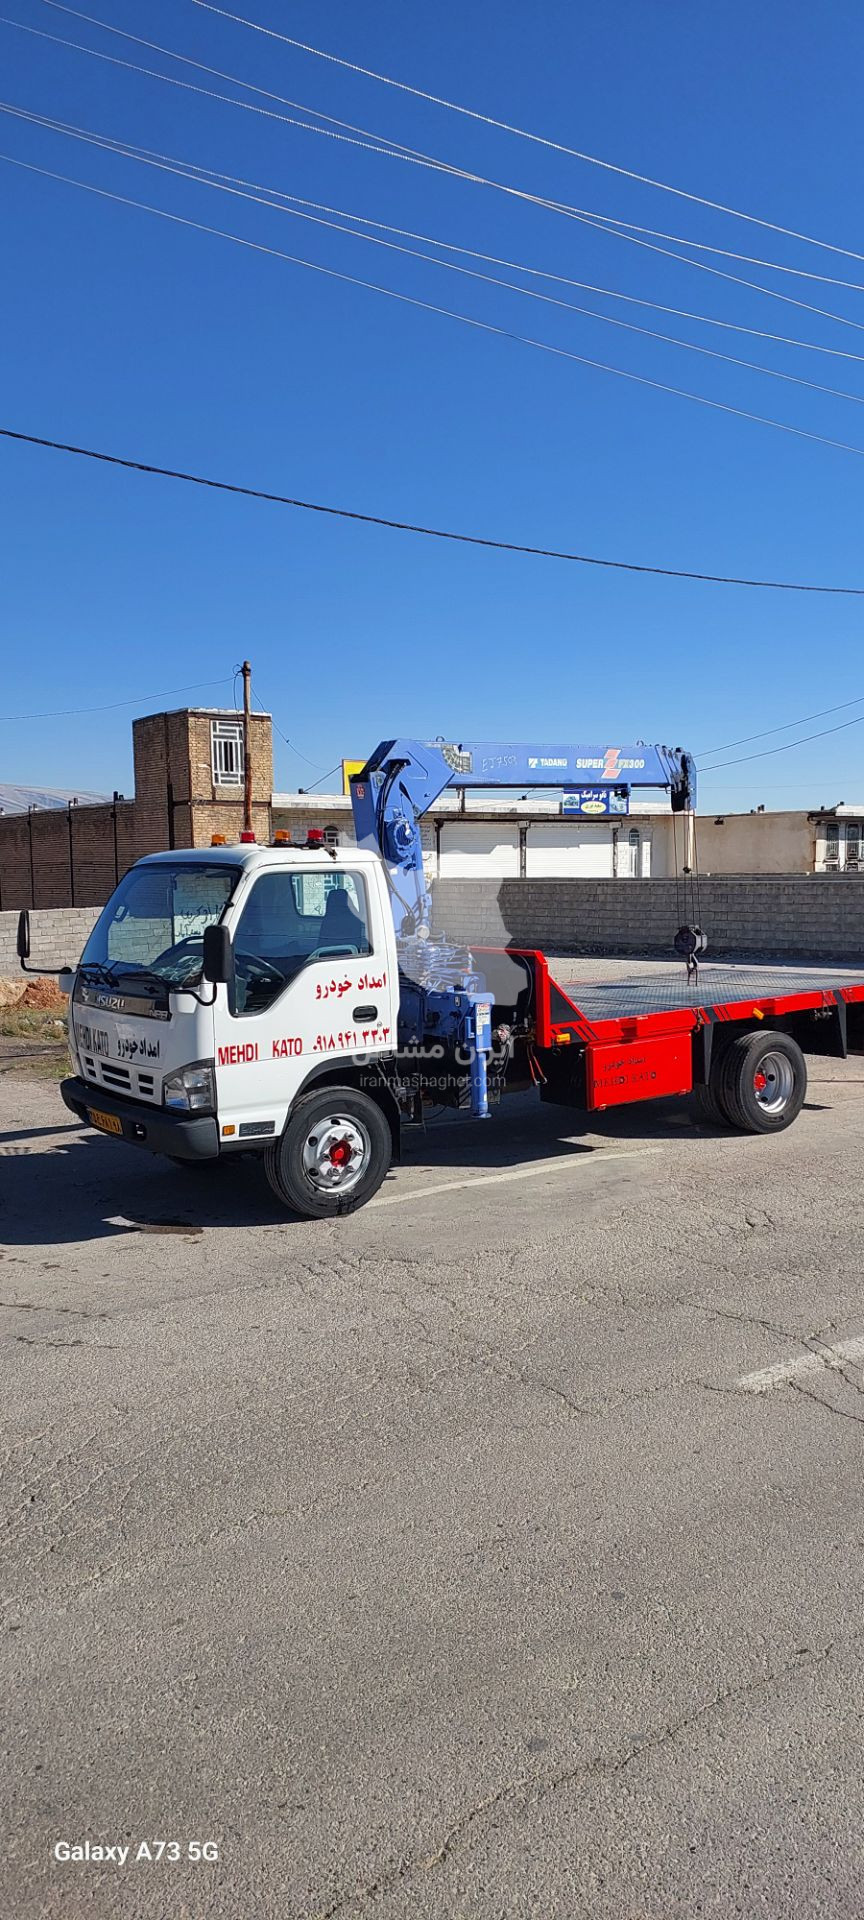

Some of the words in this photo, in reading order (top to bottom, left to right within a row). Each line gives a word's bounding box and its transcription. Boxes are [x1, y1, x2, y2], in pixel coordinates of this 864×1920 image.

[540, 757, 568, 768] TADANO
[576, 758, 604, 769] SUPER
[315, 974, 353, 1000] خودرو
[357, 972, 387, 992] امداد
[96, 994, 125, 1010] ISUZU
[139, 1037, 160, 1059] امداد
[218, 1043, 259, 1065] MEHDI
[272, 1037, 303, 1058] KATO
